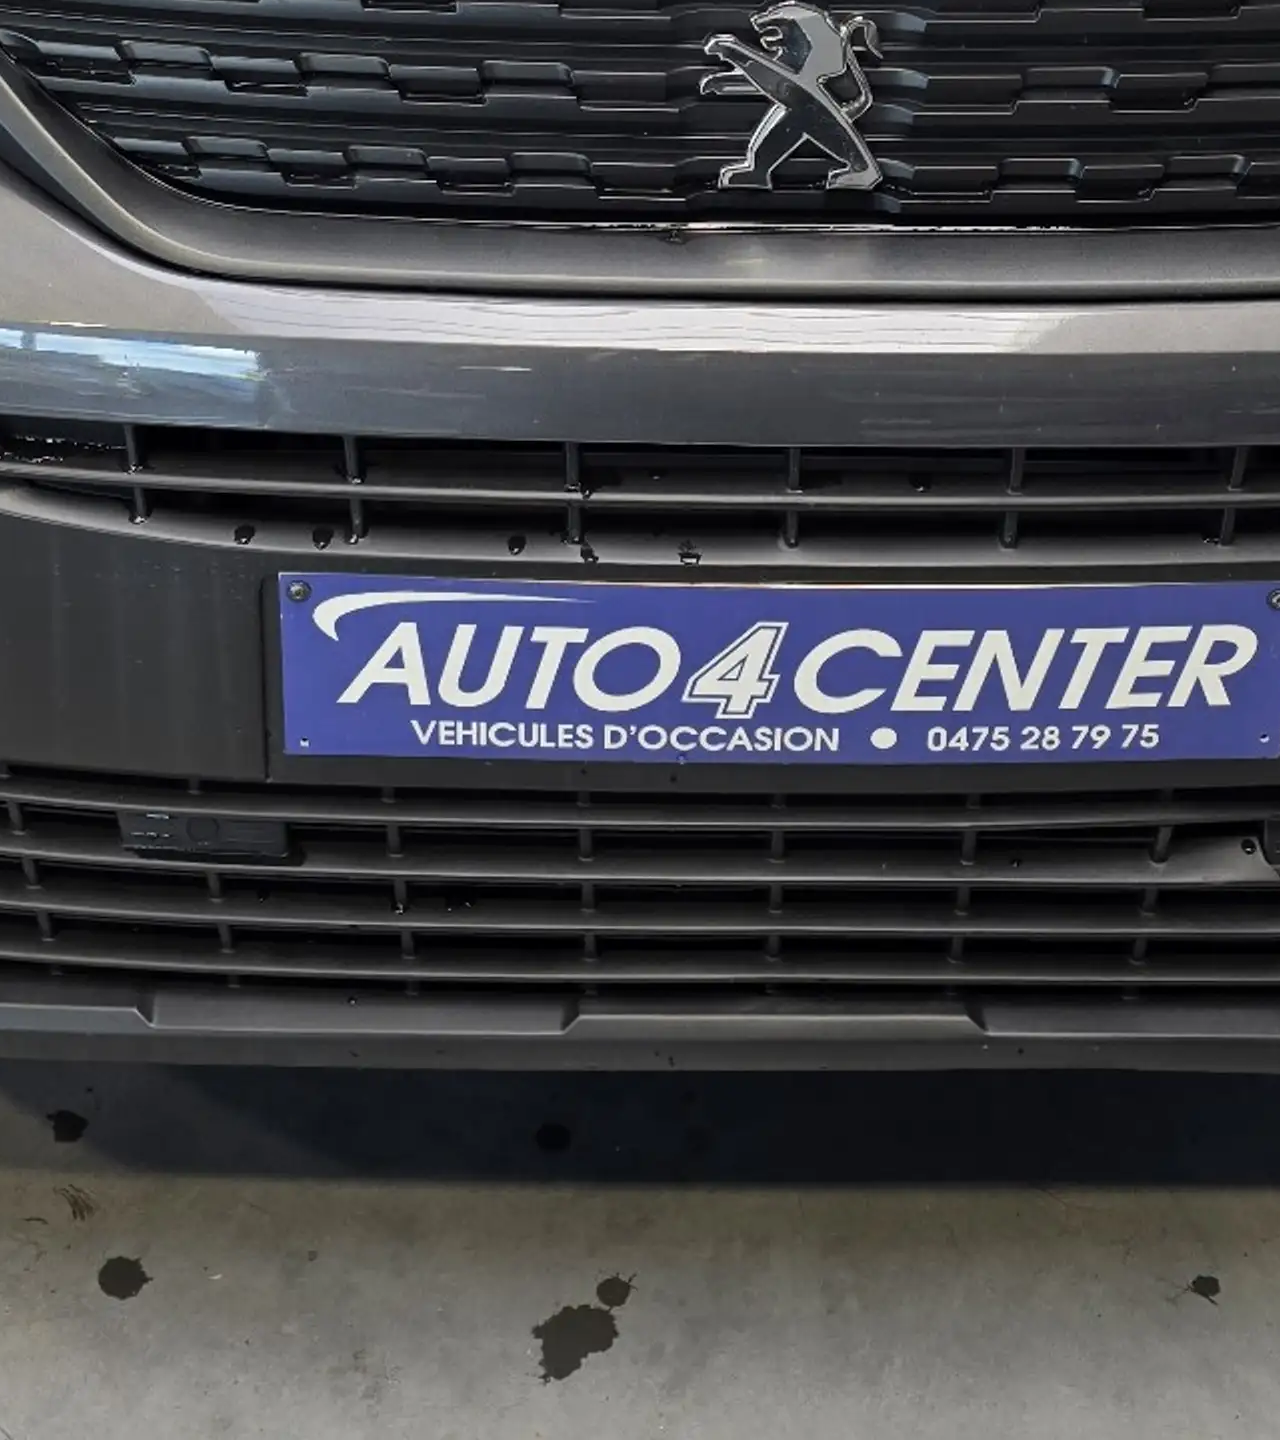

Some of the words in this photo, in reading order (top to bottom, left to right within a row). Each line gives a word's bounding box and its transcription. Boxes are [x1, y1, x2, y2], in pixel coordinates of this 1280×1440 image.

[337, 620, 1259, 720] AUTO4CENTER
[410, 719, 595, 750] VEHICULES
[603, 723, 840, 752] D'OCCASION
[926, 725, 1012, 752] 0475
[1019, 725, 1062, 752] 28
[1071, 724, 1112, 751] 79
[1121, 723, 1160, 750] 75
